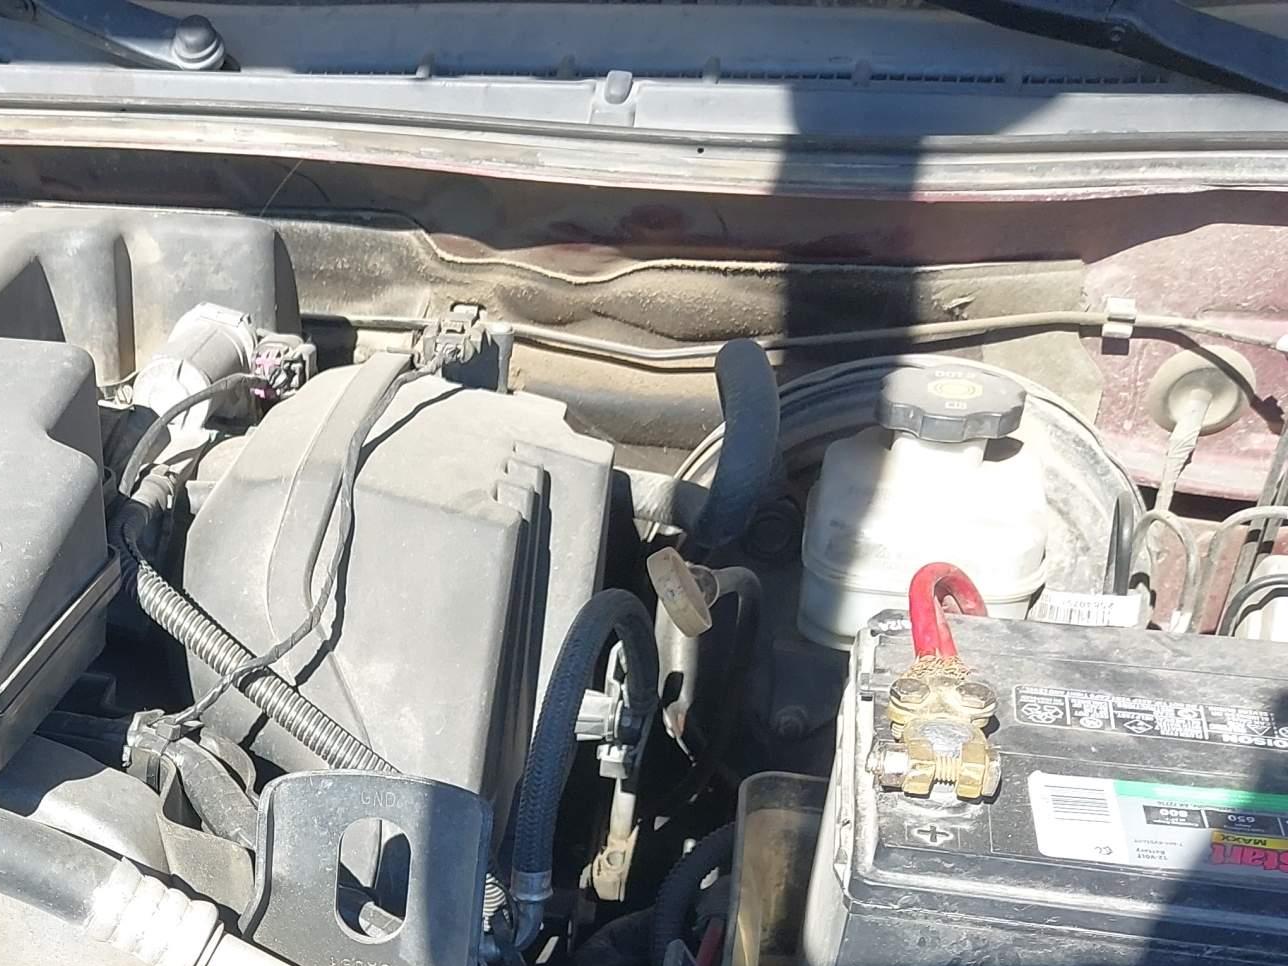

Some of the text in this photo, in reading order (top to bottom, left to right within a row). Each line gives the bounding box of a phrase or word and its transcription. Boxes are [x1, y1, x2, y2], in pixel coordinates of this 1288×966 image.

[1222, 733, 1288, 749] OISON
[360, 791, 397, 808] GND
[1227, 814, 1256, 824] 650
[1218, 834, 1267, 847] MAXX
